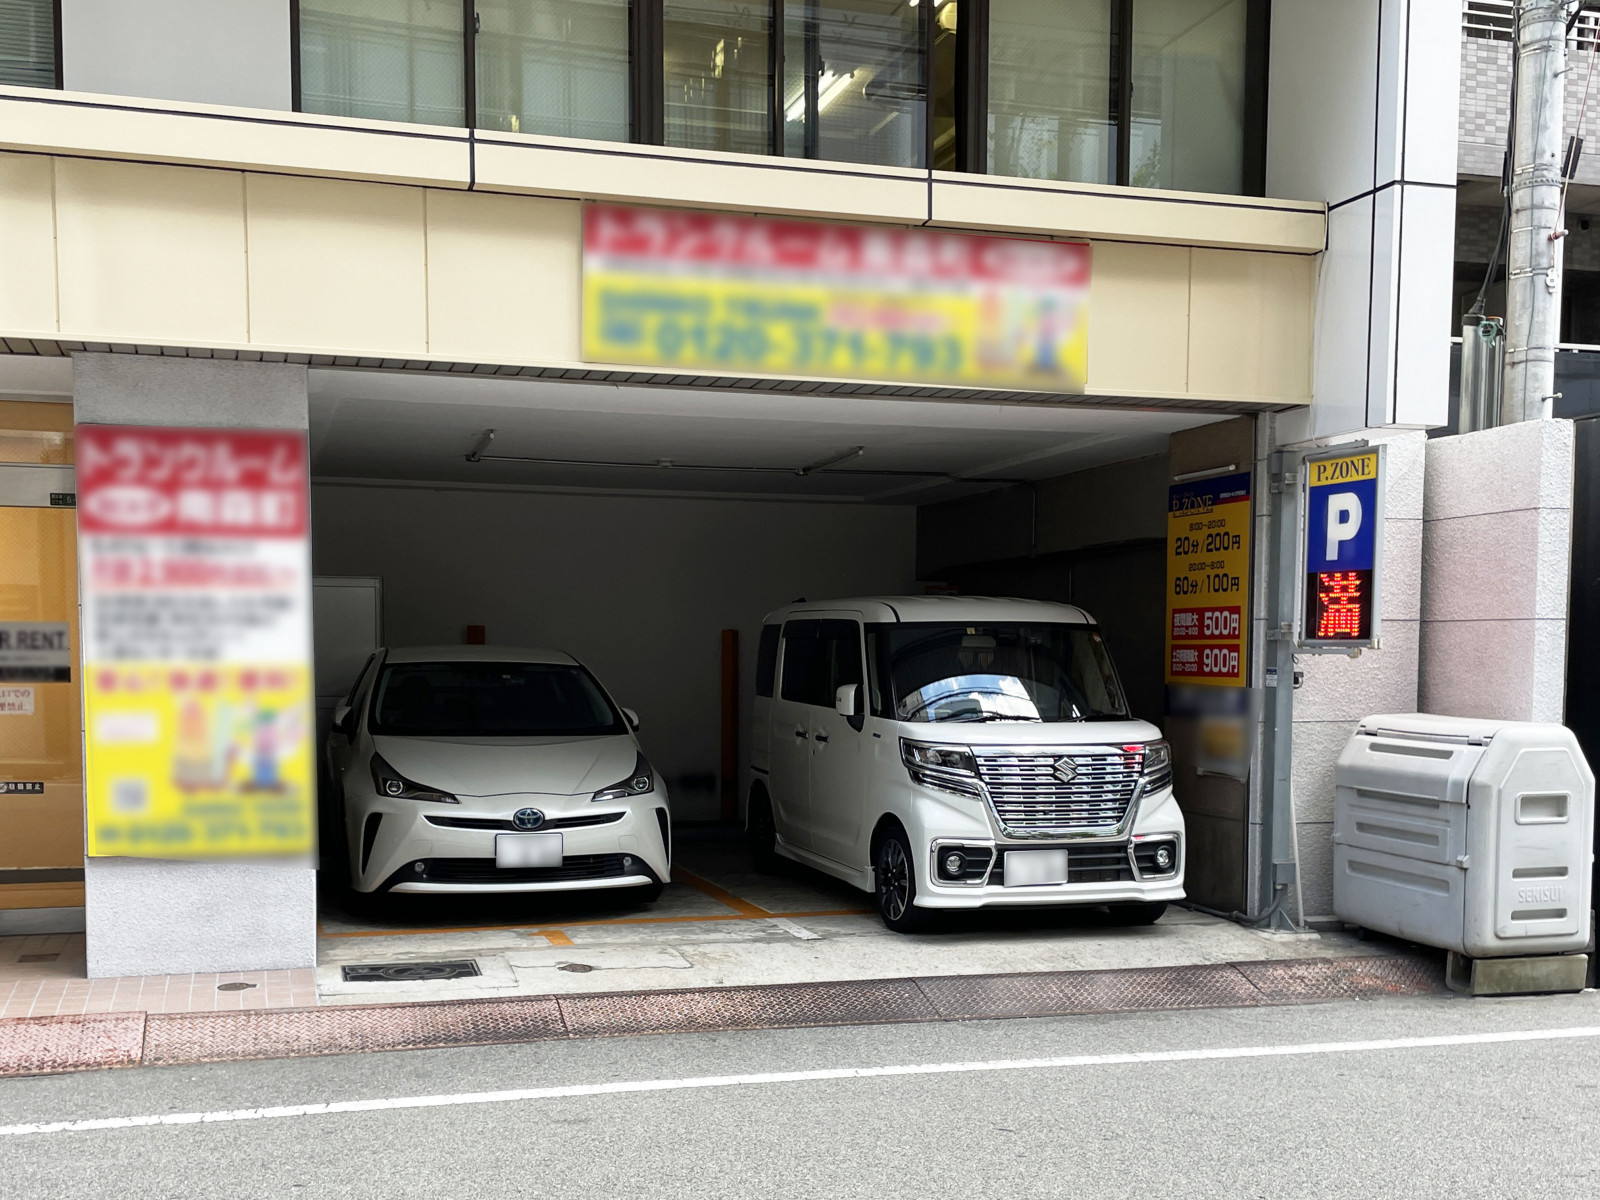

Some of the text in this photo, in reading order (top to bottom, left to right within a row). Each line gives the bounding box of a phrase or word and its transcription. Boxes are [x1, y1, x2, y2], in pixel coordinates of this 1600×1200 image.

[1316, 457, 1372, 482] P.ZONE
[1326, 491, 1363, 561] P
[1203, 611, 1239, 636] 500円
[16, 630, 65, 650] RENT
[1202, 648, 1238, 673] 900円
[0, 688, 31, 698] 口での
